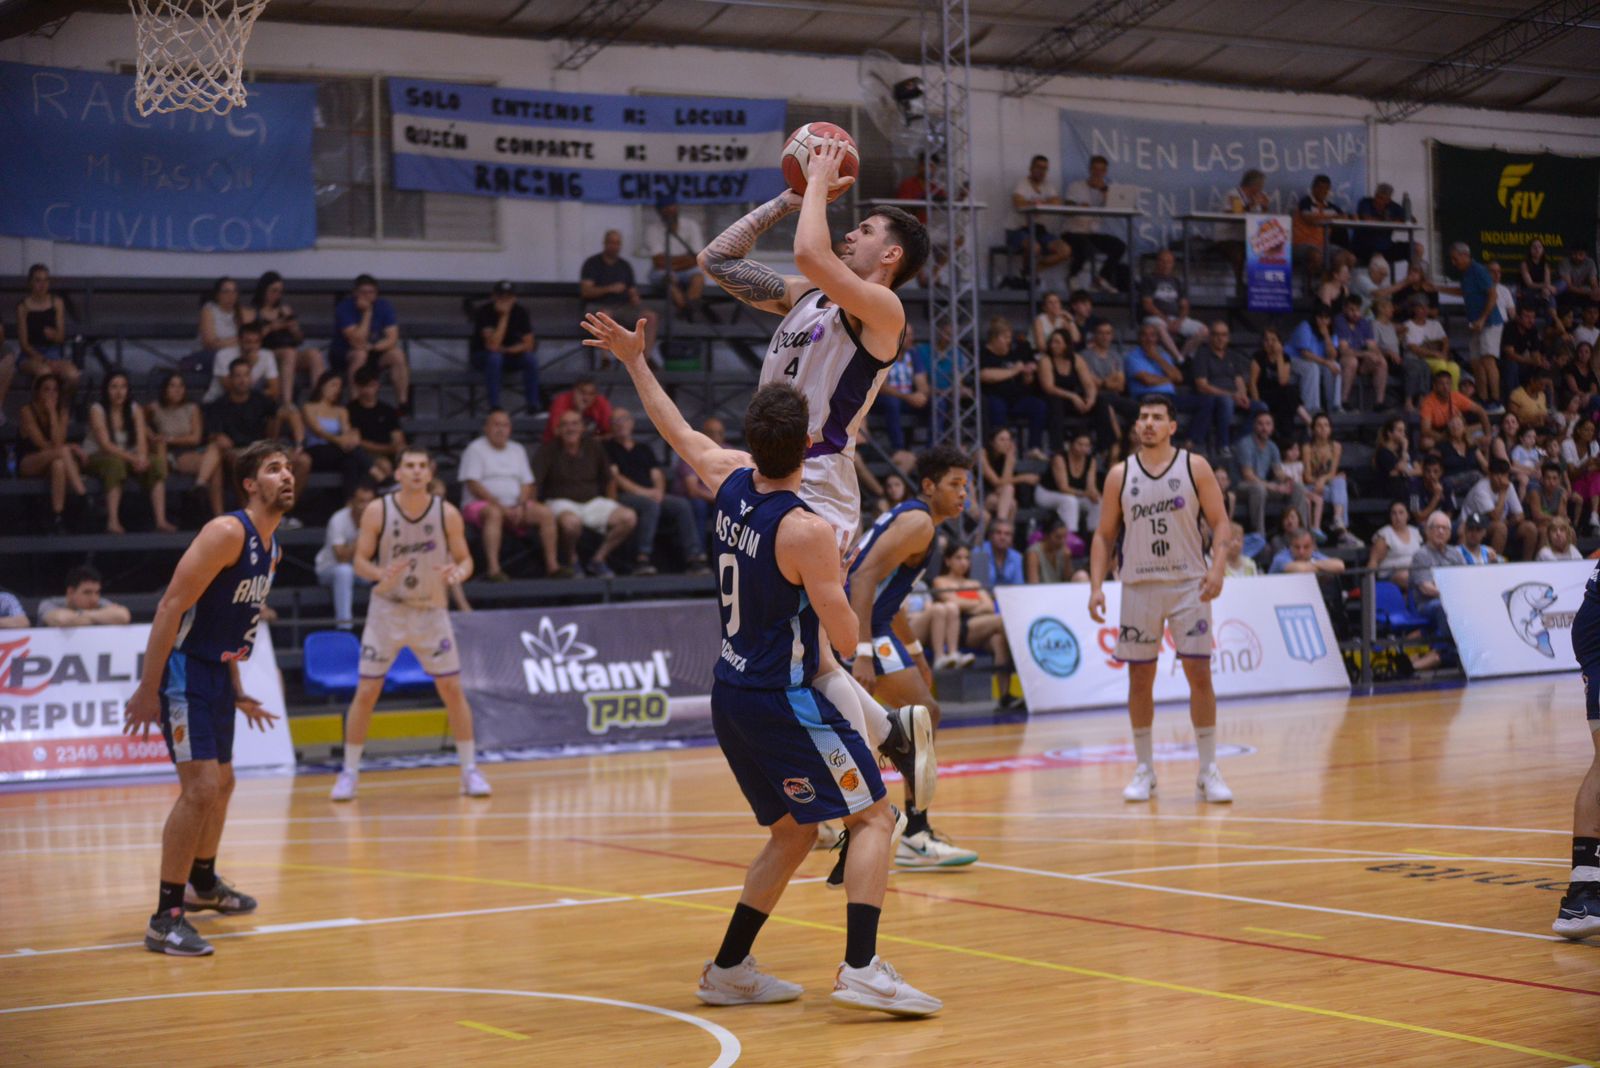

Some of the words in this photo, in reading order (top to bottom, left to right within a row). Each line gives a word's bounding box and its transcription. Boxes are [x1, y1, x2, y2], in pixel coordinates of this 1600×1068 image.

[405, 87, 461, 112] SOLO
[675, 107, 747, 127] LOCURA
[495, 136, 595, 161] COMPARTE
[1192, 138, 1245, 172] LAS
[474, 164, 583, 200] RACING
[43, 204, 280, 252] CHIVILCOY
[784, 356, 799, 379] 4
[715, 509, 761, 559] ASSUM
[1150, 518, 1168, 535] 15
[718, 553, 741, 638] 9
[522, 650, 671, 695] Nitanyl
[0, 699, 130, 733] REPUE
[588, 694, 669, 729] PRO
